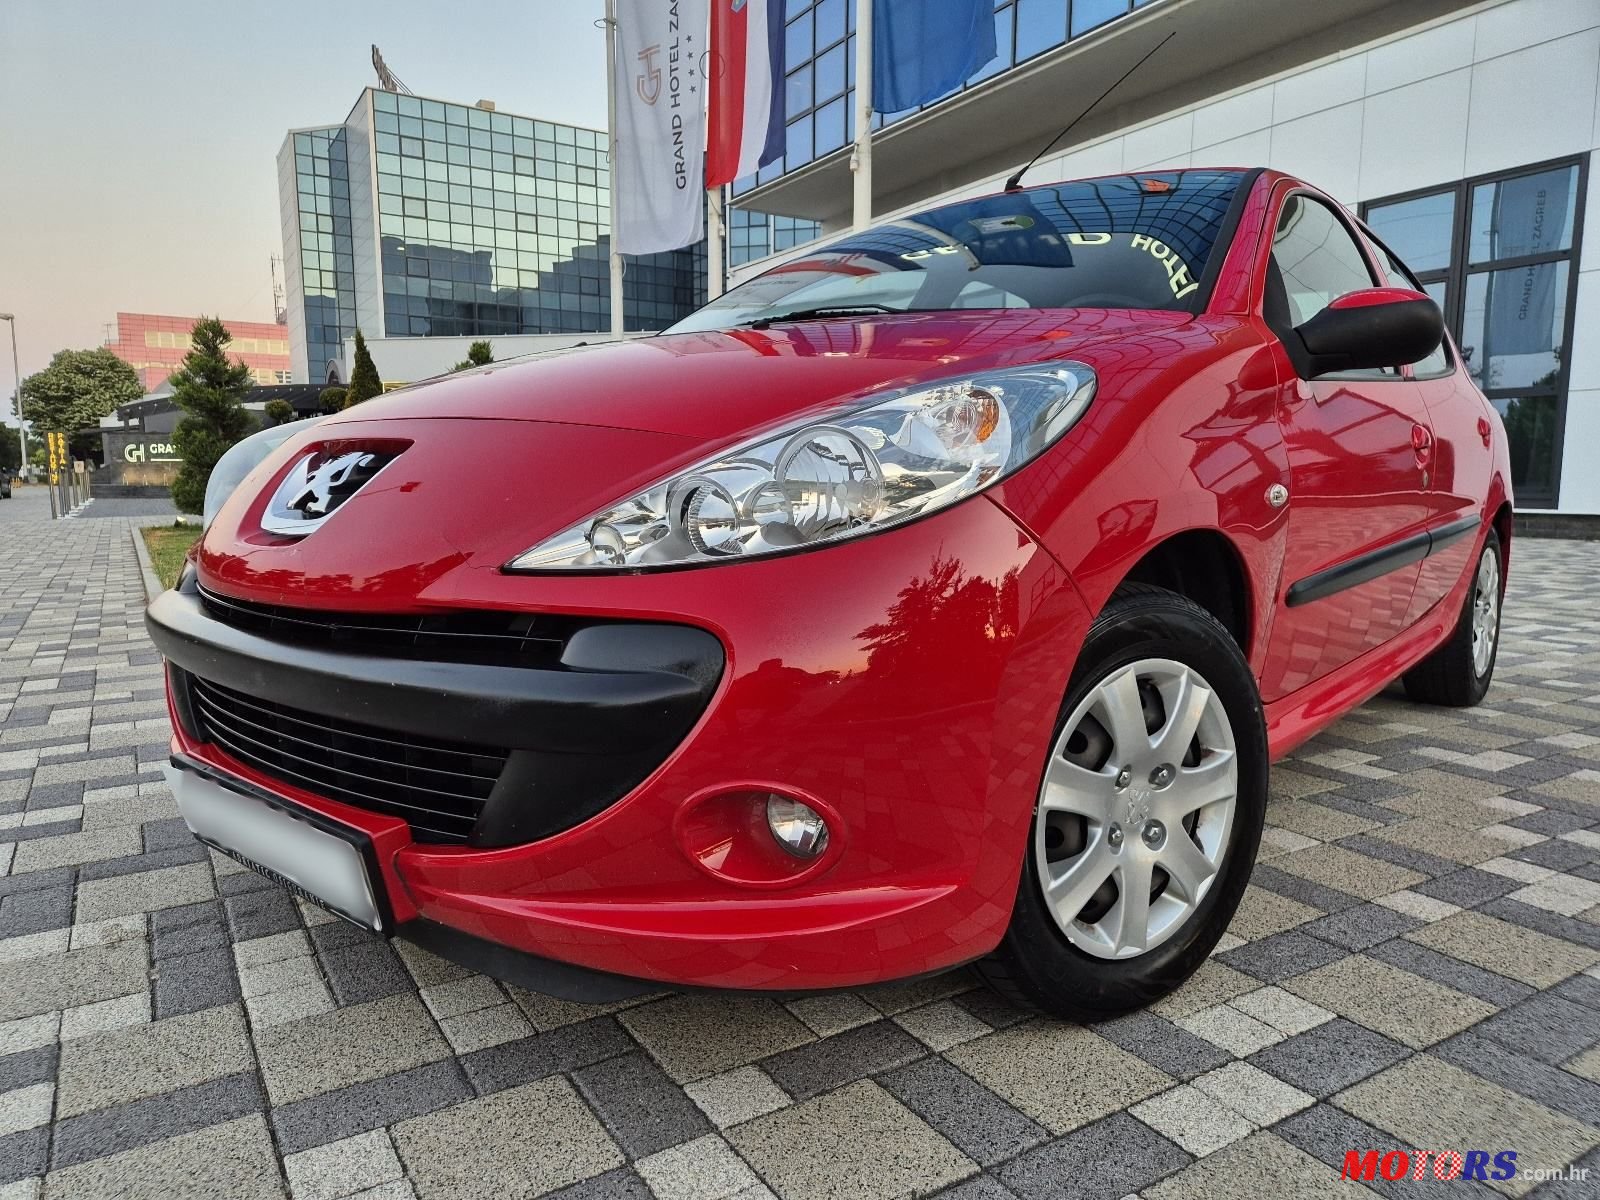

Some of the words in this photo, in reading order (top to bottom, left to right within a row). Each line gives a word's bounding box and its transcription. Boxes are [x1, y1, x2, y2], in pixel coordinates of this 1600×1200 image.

[669, 0, 680, 33] ZA
[669, 36, 681, 108] HOTEL
[672, 114, 687, 189] GRAND
[1518, 279, 1533, 321] GRAND
[1533, 190, 1546, 240] ZAGREB
